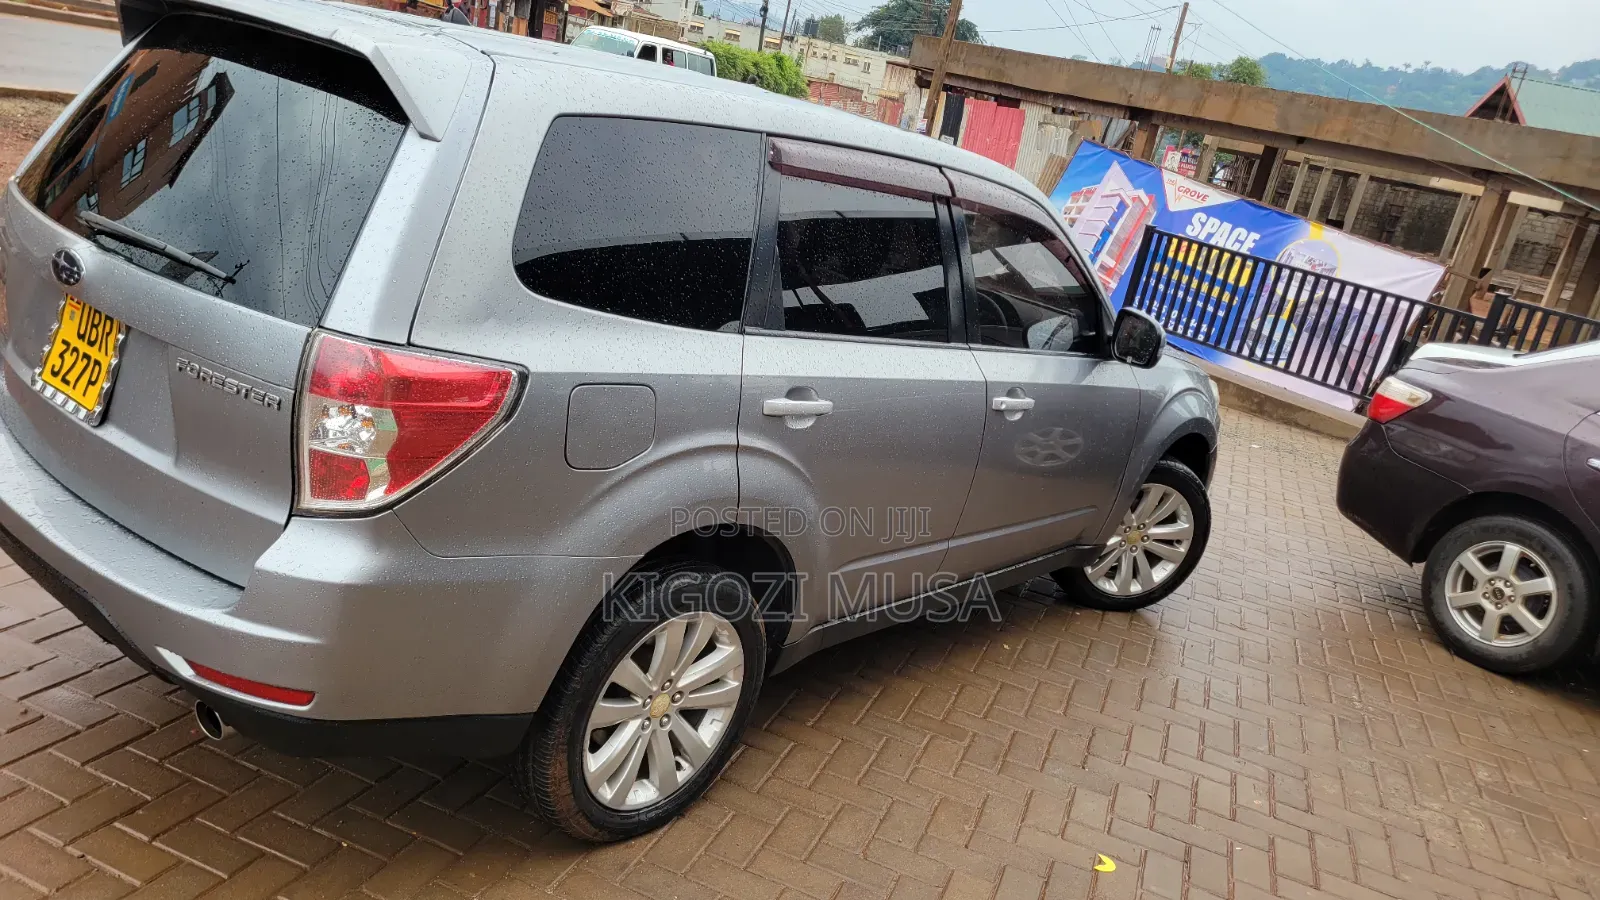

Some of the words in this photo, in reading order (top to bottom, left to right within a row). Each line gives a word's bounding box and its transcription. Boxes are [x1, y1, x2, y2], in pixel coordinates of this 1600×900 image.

[1177, 185, 1209, 202] GROVE
[1186, 212, 1260, 254] SPACE
[77, 302, 115, 357] UBR
[50, 338, 102, 398] 327P
[176, 356, 282, 411] FORESTER
